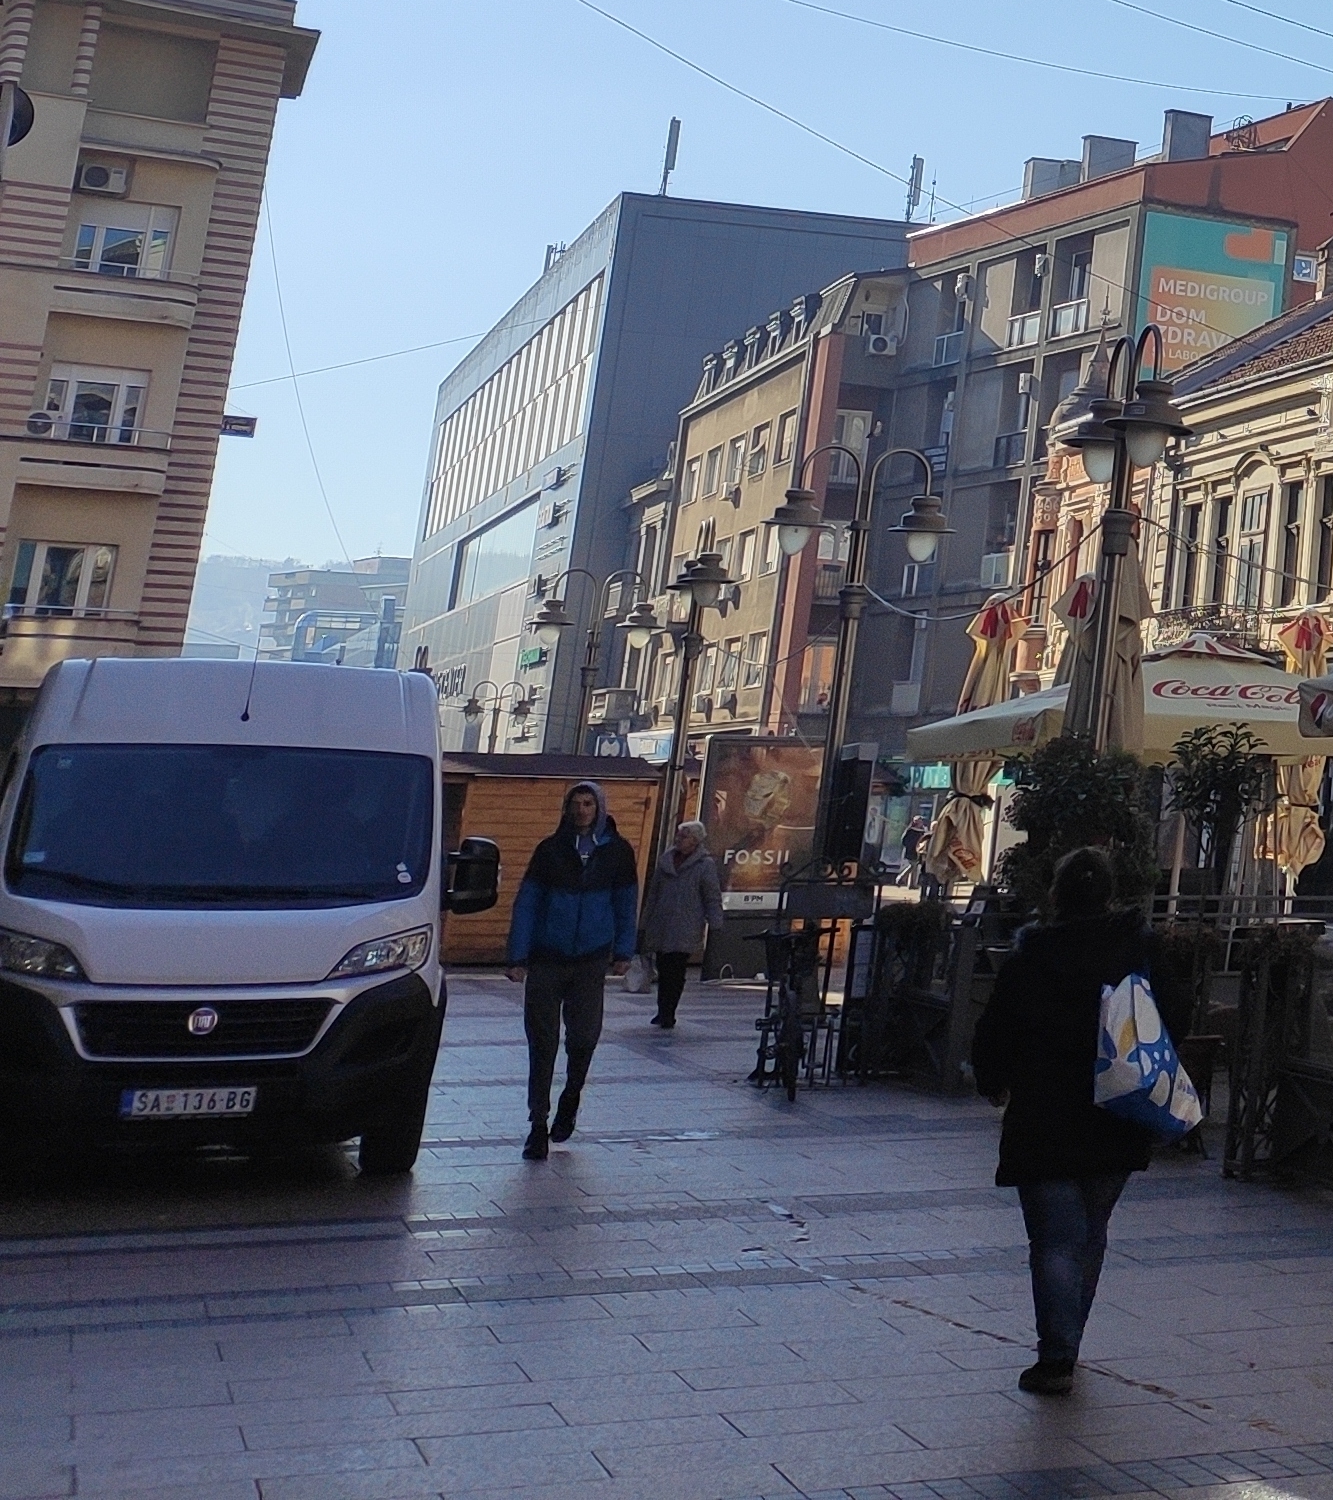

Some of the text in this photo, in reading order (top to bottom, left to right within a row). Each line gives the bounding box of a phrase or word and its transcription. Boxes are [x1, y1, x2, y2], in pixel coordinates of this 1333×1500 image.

[1158, 277, 1269, 306] MEDIGROUP
[1156, 303, 1207, 325] DOM
[194, 1015, 213, 1029] FIAT
